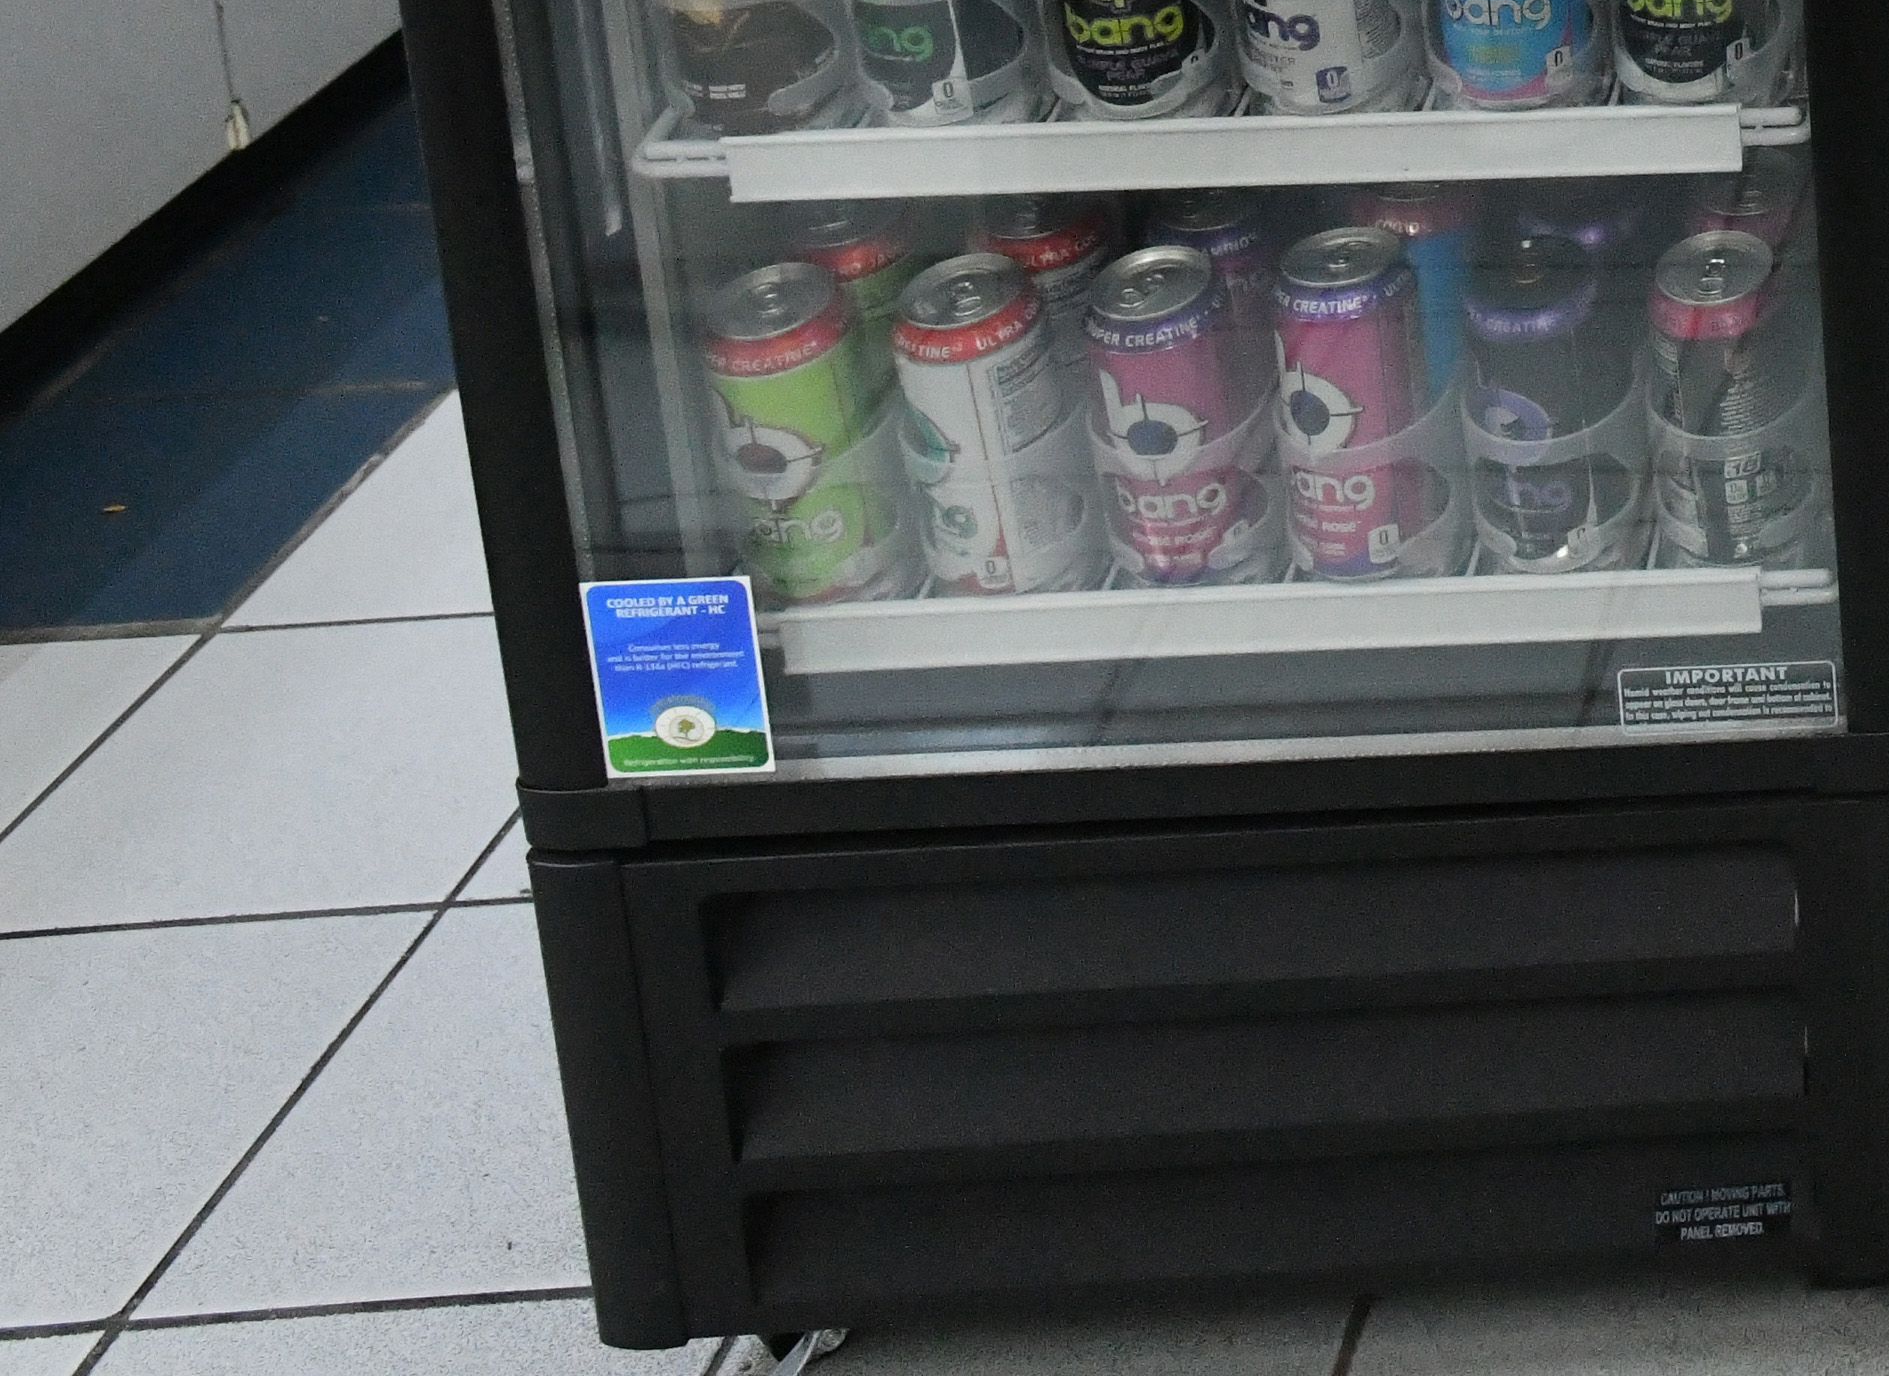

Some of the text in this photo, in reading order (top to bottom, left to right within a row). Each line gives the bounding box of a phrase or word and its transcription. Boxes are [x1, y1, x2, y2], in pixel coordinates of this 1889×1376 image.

[1064, 1, 1185, 46] bang
[1293, 296, 1364, 315] CREATINE
[1125, 319, 1198, 348] CREATINE
[1116, 478, 1228, 519] bang
[607, 594, 729, 609] COOLED BY A GREEN
[616, 605, 726, 618] REFRIGERANT HC
[1665, 666, 1788, 685] IMPORTANT
[1655, 1210, 1670, 1224] DO
[1672, 1208, 1692, 1223] NOT
[1695, 1204, 1740, 1221] OPERATE
[1742, 1202, 1764, 1218] UNIT
[1681, 1225, 1713, 1240] PANEL
